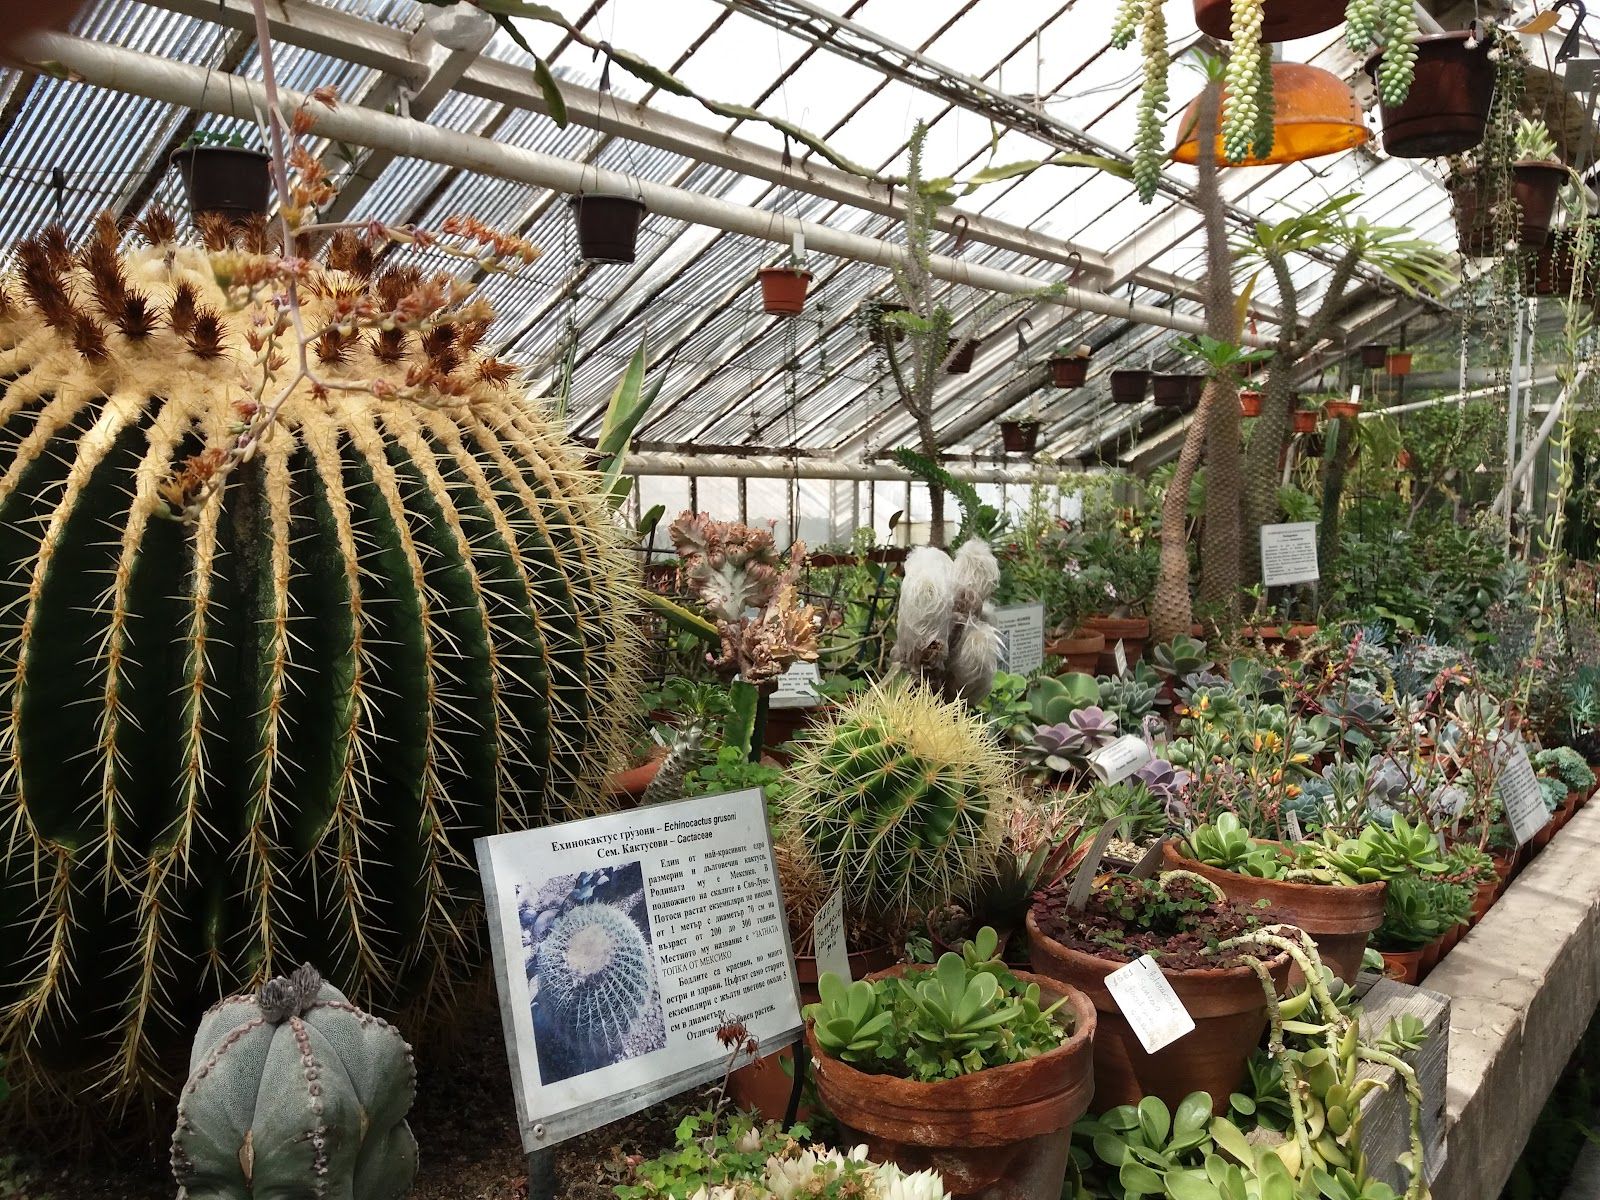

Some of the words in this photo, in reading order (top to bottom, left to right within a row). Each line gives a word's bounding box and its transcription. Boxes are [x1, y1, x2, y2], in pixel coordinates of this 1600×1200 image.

[551, 834, 618, 852] Ехинокактус
[664, 816, 712, 832] Echinocactus
[597, 847, 620, 858] Сем.
[622, 840, 668, 855] Кактусови
[677, 831, 713, 844] Cactaceae
[660, 858, 680, 868] Един
[648, 870, 684, 886] размерни
[650, 884, 686, 897] Родината
[697, 879, 706, 888] му
[652, 895, 696, 911] подножието
[710, 886, 734, 896] скалите
[654, 912, 682, 924] Потоси
[684, 906, 706, 919] растат
[670, 925, 674, 934] 1
[680, 920, 702, 931] метър
[716, 910, 744, 922] диаметър
[658, 938, 688, 950] възраст
[710, 926, 722, 937] 200
[728, 925, 736, 934] до
[742, 918, 752, 928] 300
[660, 950, 696, 965] Местното
[700, 945, 710, 954] му
[714, 937, 742, 950] название
[662, 964, 688, 978] ТОПКА
[688, 960, 698, 970] ОТ
[700, 950, 732, 966] МЕКСИКО
[666, 993, 688, 1005] остри
[724, 972, 748, 987] Цъфтят
[678, 972, 708, 986] Бодлите
[668, 998, 712, 1018] екземпляри
[720, 990, 740, 1002] жълти
[670, 1024, 680, 1032] см
